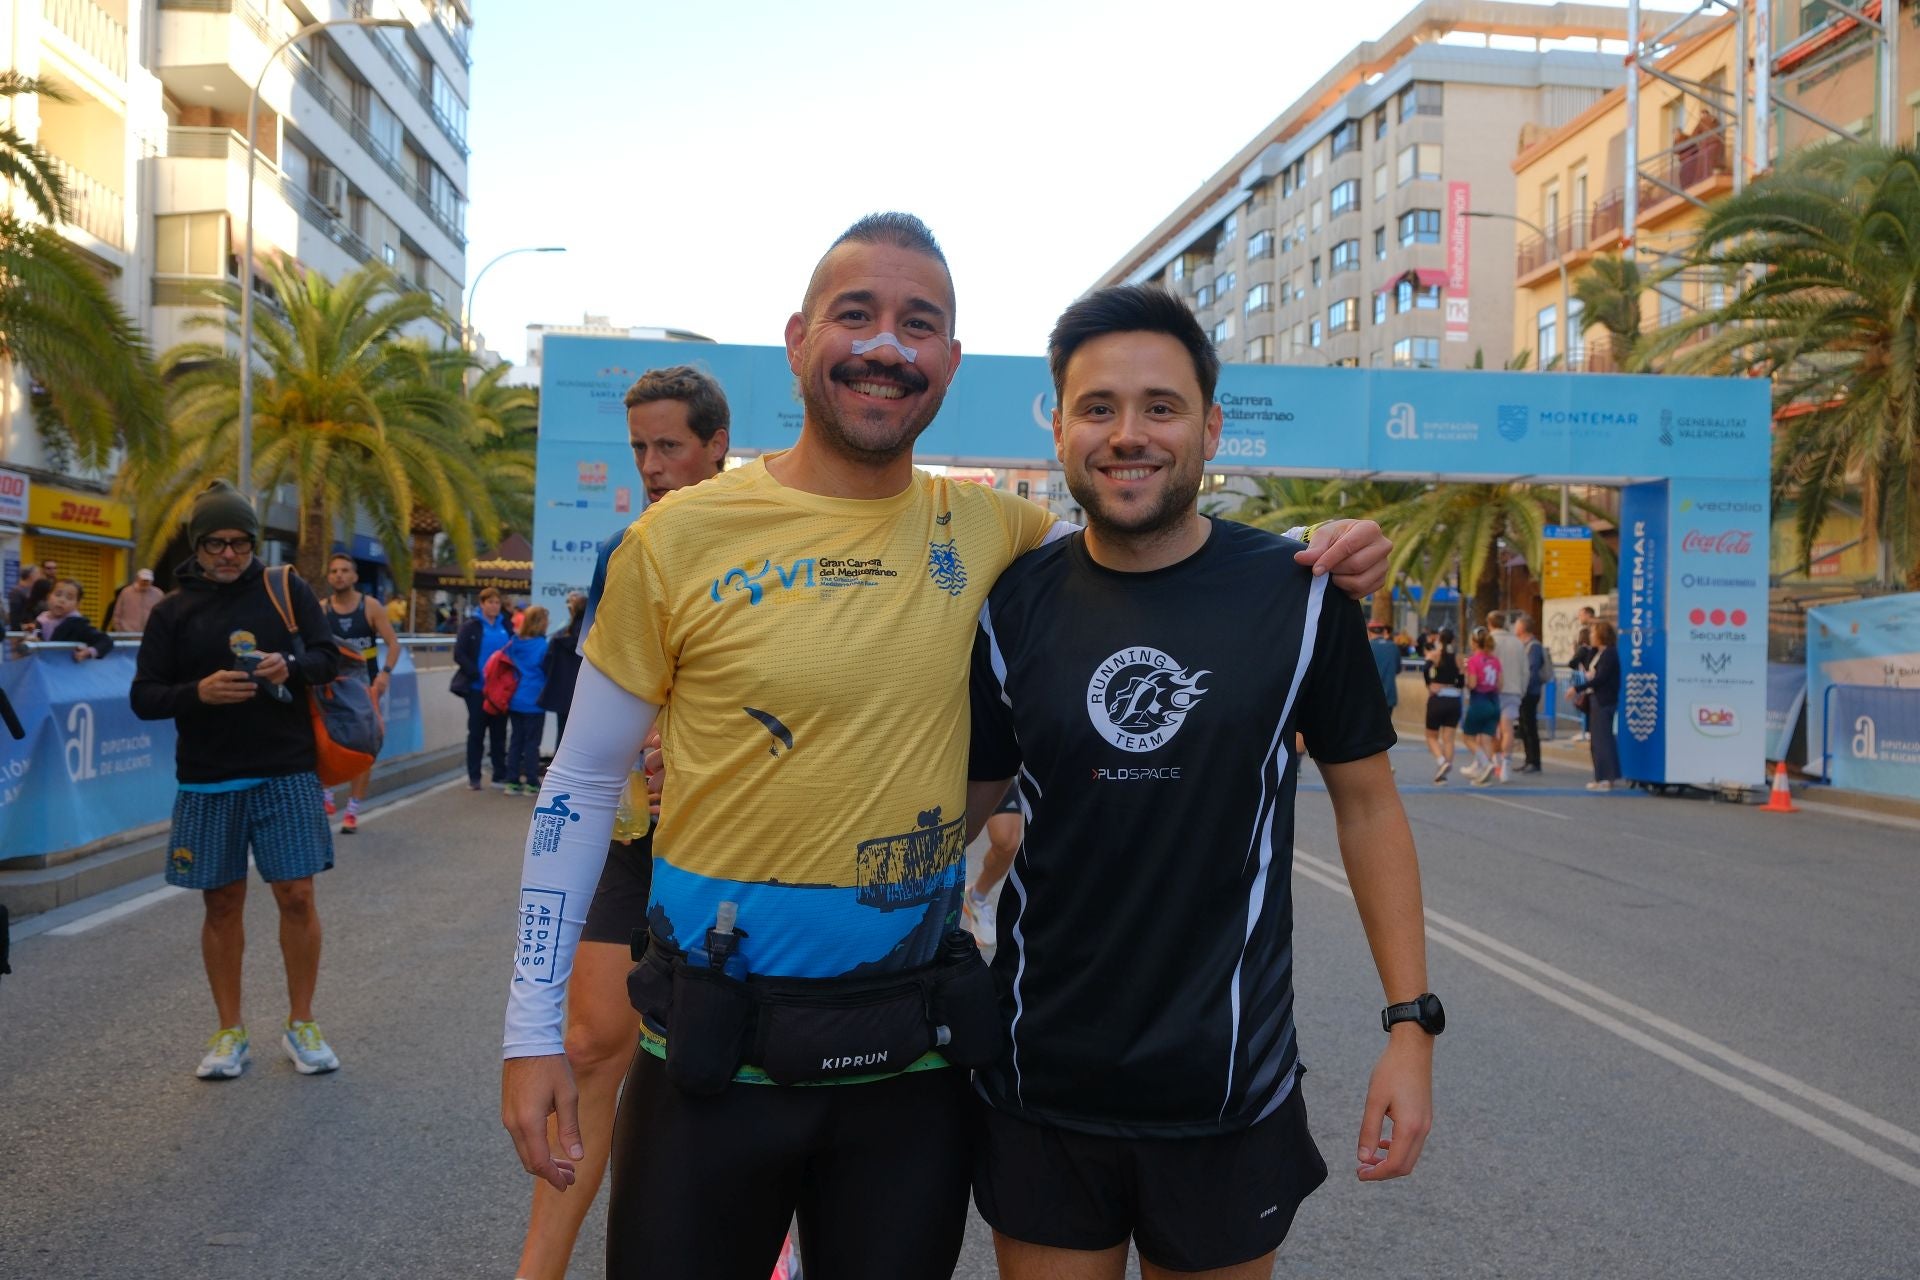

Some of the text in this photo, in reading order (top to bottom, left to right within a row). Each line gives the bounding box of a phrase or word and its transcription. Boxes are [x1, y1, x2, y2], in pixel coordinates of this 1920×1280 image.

[1221, 392, 1273, 406] Carrera
[1223, 408, 1295, 421] editerráneo
[1540, 411, 1638, 425] MONTEMAR
[1217, 438, 1267, 457] 2025
[58, 500, 104, 525] DHL
[775, 558, 882, 589] VI Gran Carrera
[820, 568, 897, 577] del Mediterráneo
[1631, 521, 1645, 667] MONTEMAR
[1690, 629, 1746, 641] Securitas
[1091, 650, 1167, 704] RUNNING
[1699, 707, 1733, 723] Dole
[101, 734, 151, 755] DIPUTACIÓN
[1116, 732, 1164, 749] TEAM
[521, 904, 535, 966] HOMES
[534, 905, 550, 966] AEDAS
[822, 1050, 888, 1070] KIPRUN
